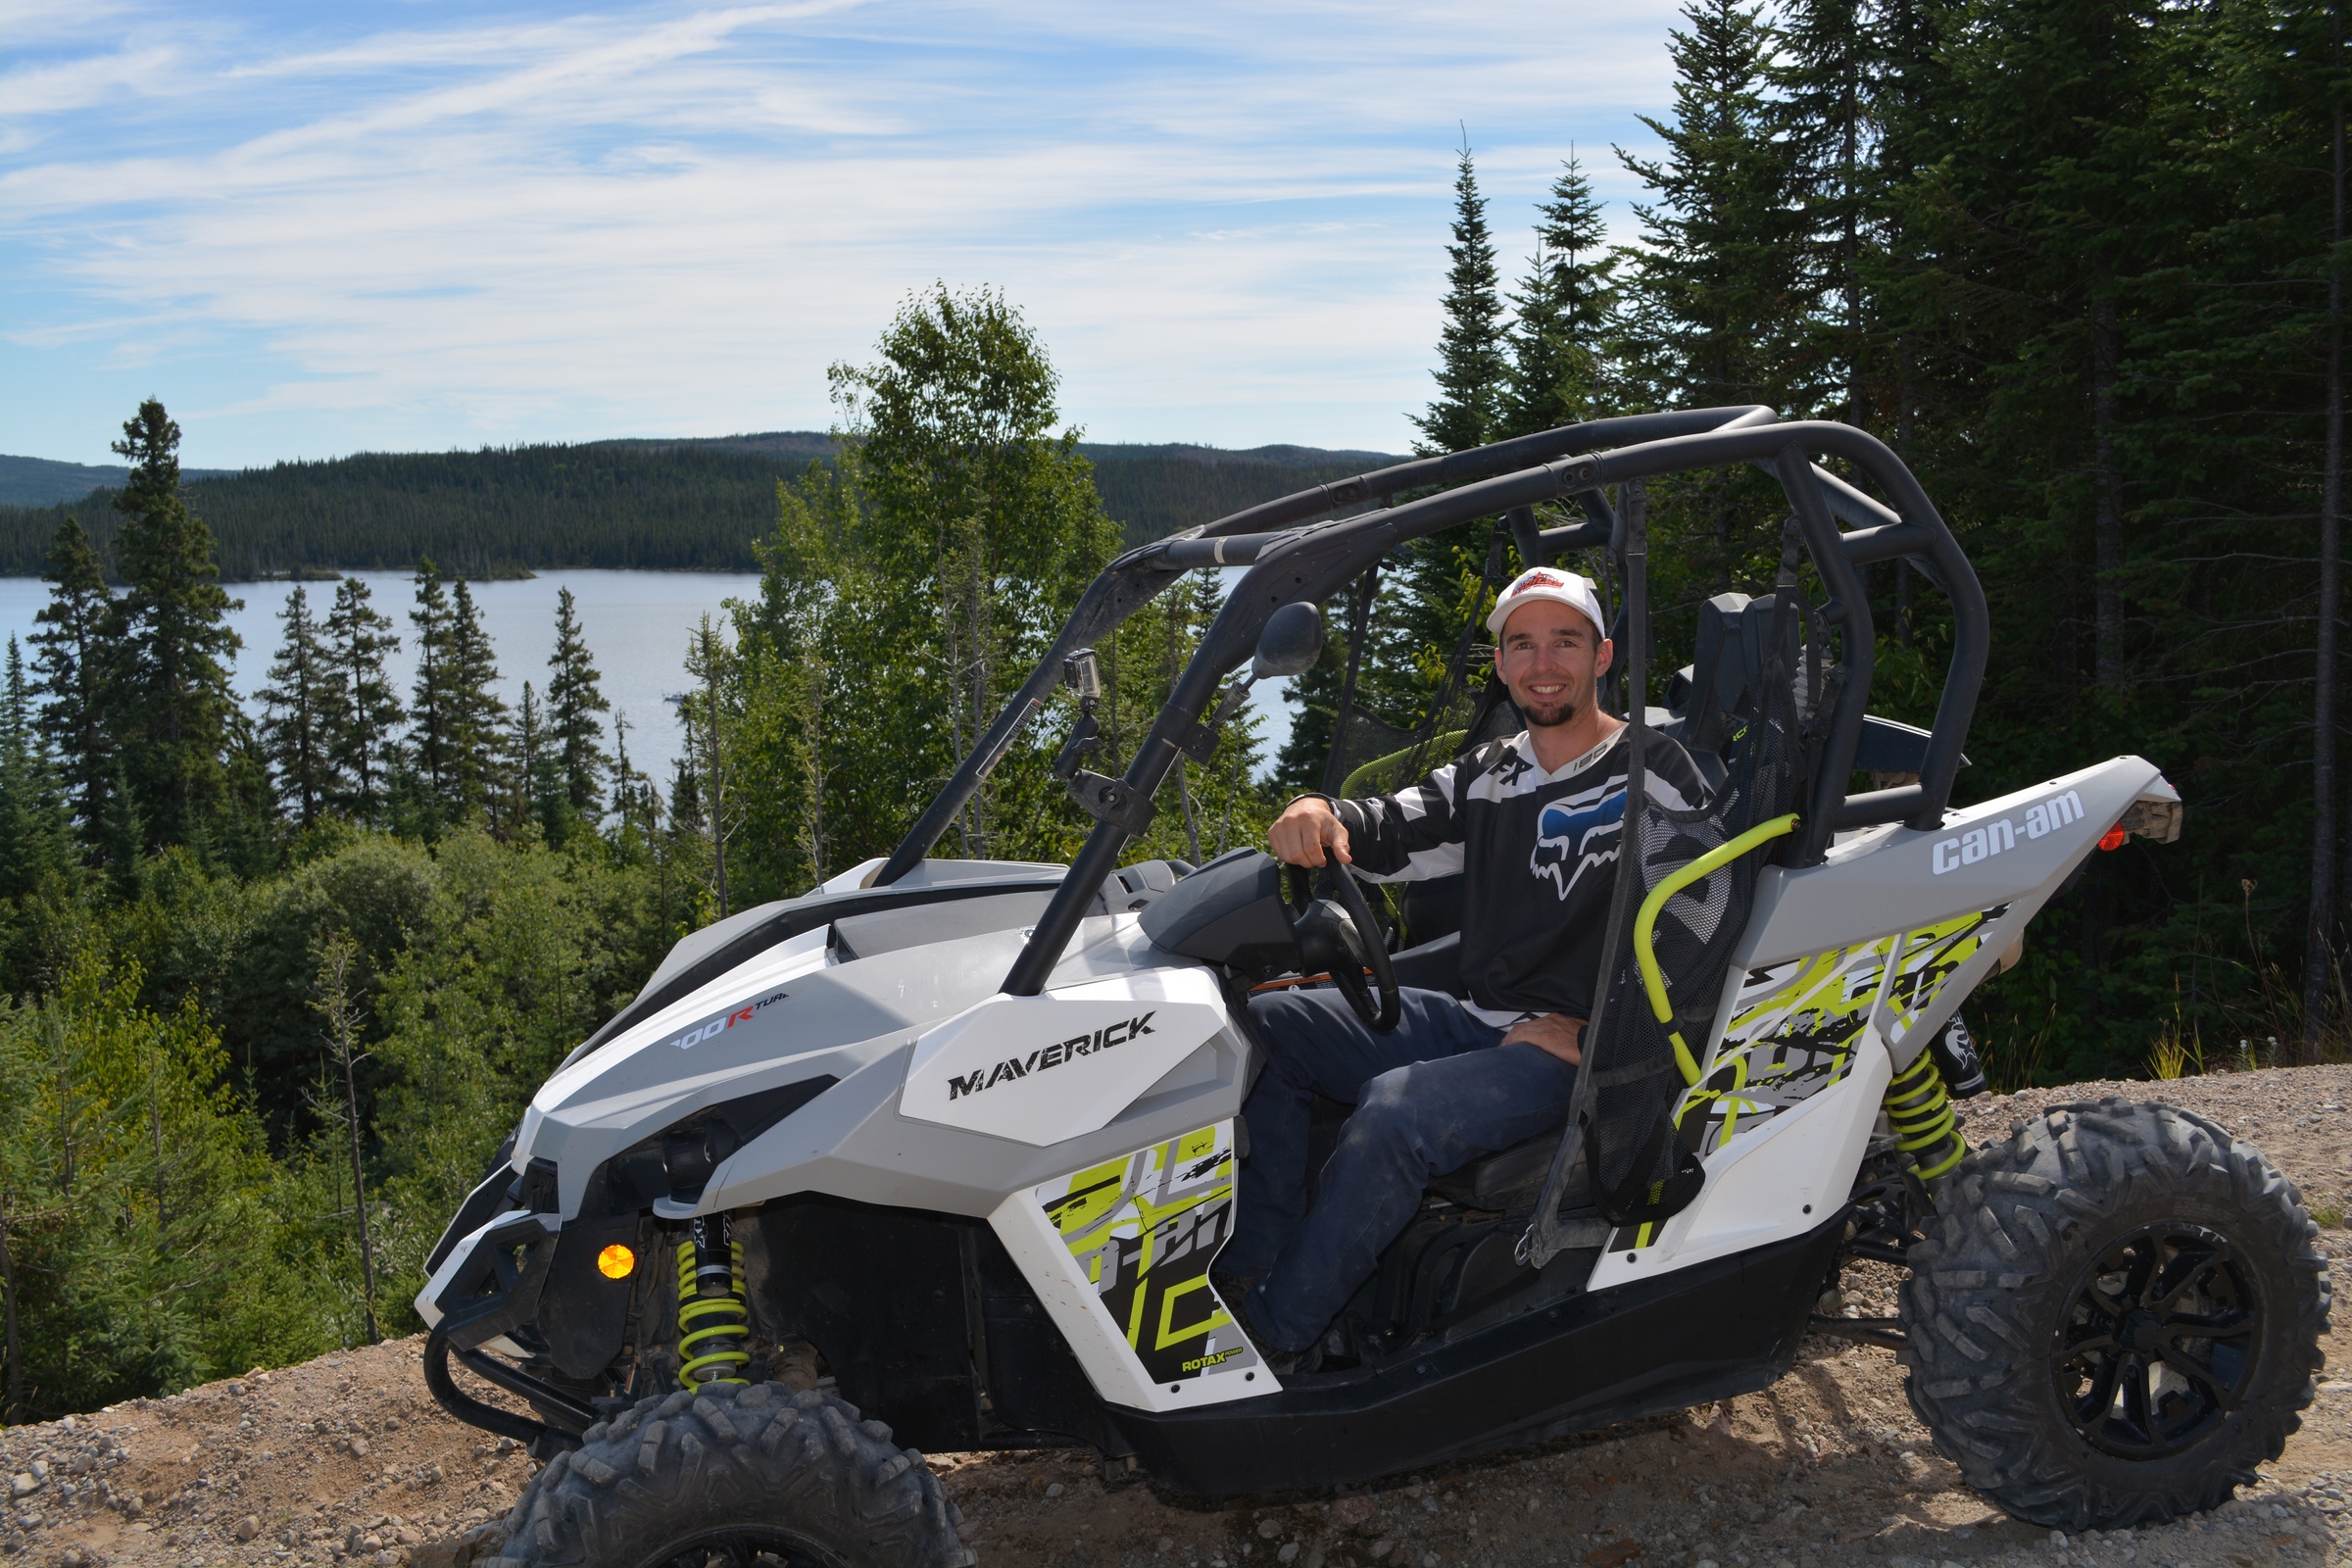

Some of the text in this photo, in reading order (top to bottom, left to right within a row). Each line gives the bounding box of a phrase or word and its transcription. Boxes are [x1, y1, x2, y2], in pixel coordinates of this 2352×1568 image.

[1932, 790, 2085, 875] can-am
[947, 1010, 1156, 1101] MAVERICK
[1182, 1352, 1225, 1372] ROTAX
